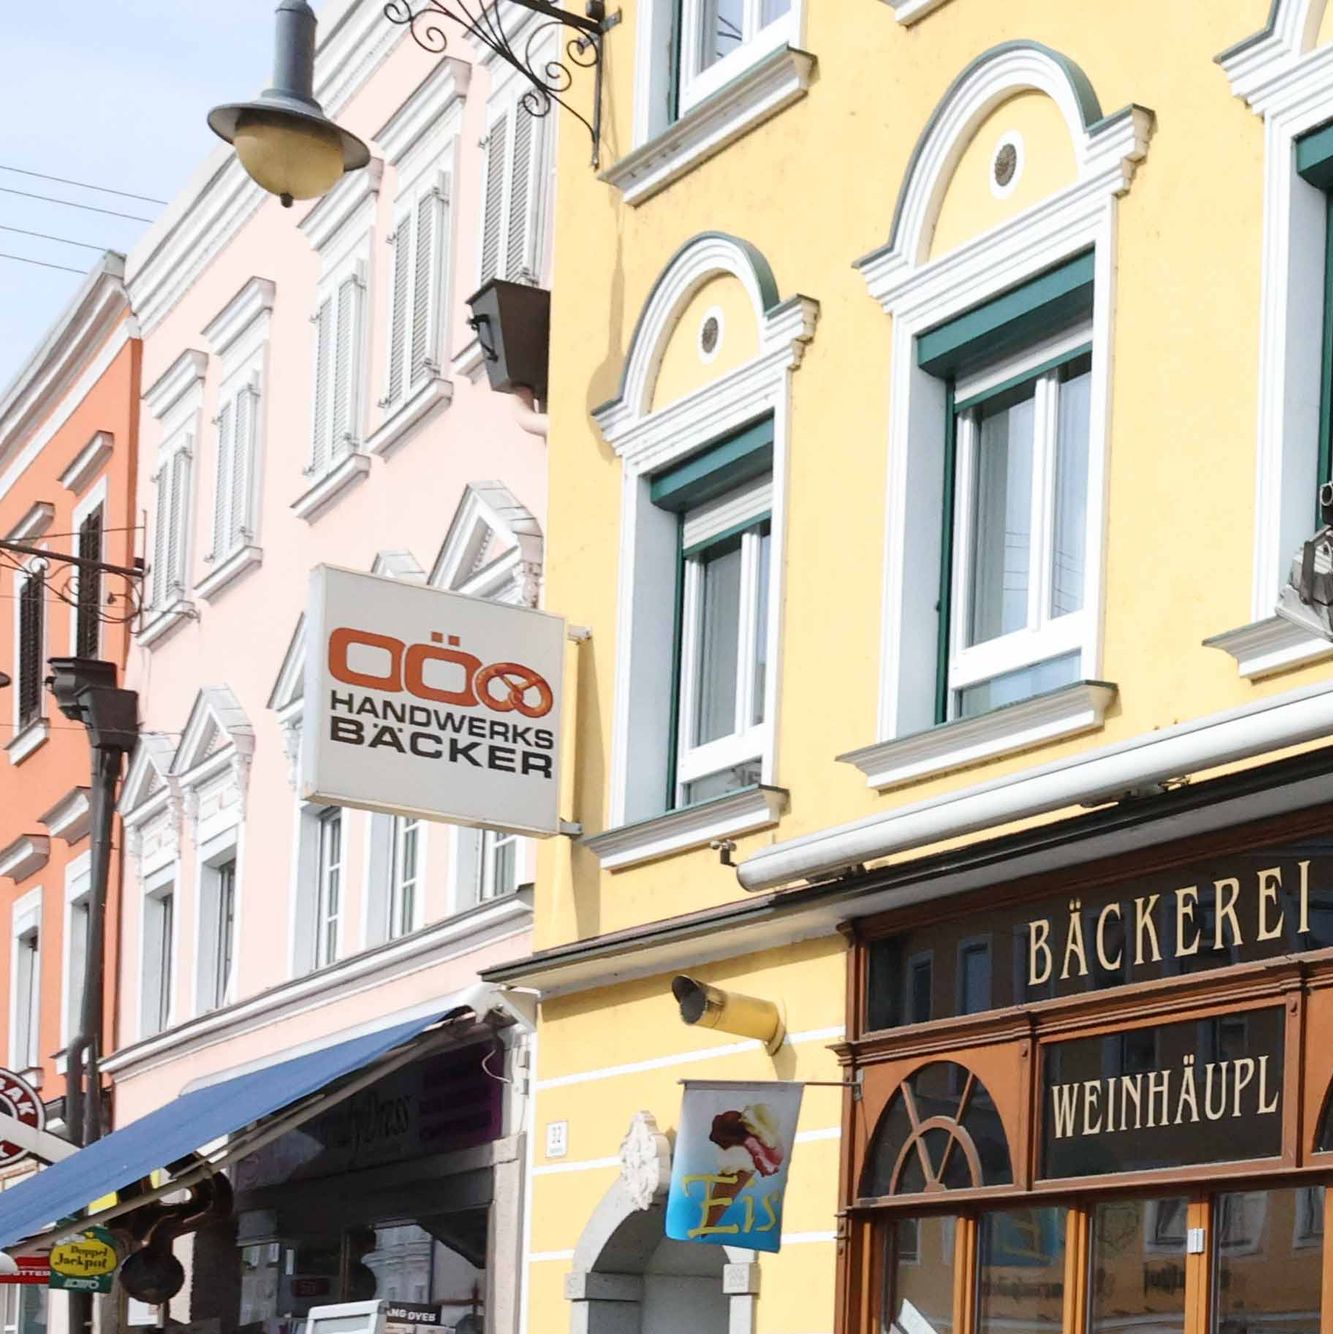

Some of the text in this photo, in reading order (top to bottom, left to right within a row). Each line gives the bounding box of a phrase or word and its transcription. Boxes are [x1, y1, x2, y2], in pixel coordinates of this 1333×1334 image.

[330, 689, 554, 750] HANDWERKS
[330, 715, 553, 779] BÄCKER
[1027, 860, 1312, 987] BÄCKEREI
[1051, 1054, 1280, 1139] WEINHÄUPL
[681, 1173, 782, 1240] Eis
[54, 1253, 108, 1271] Jackpot
